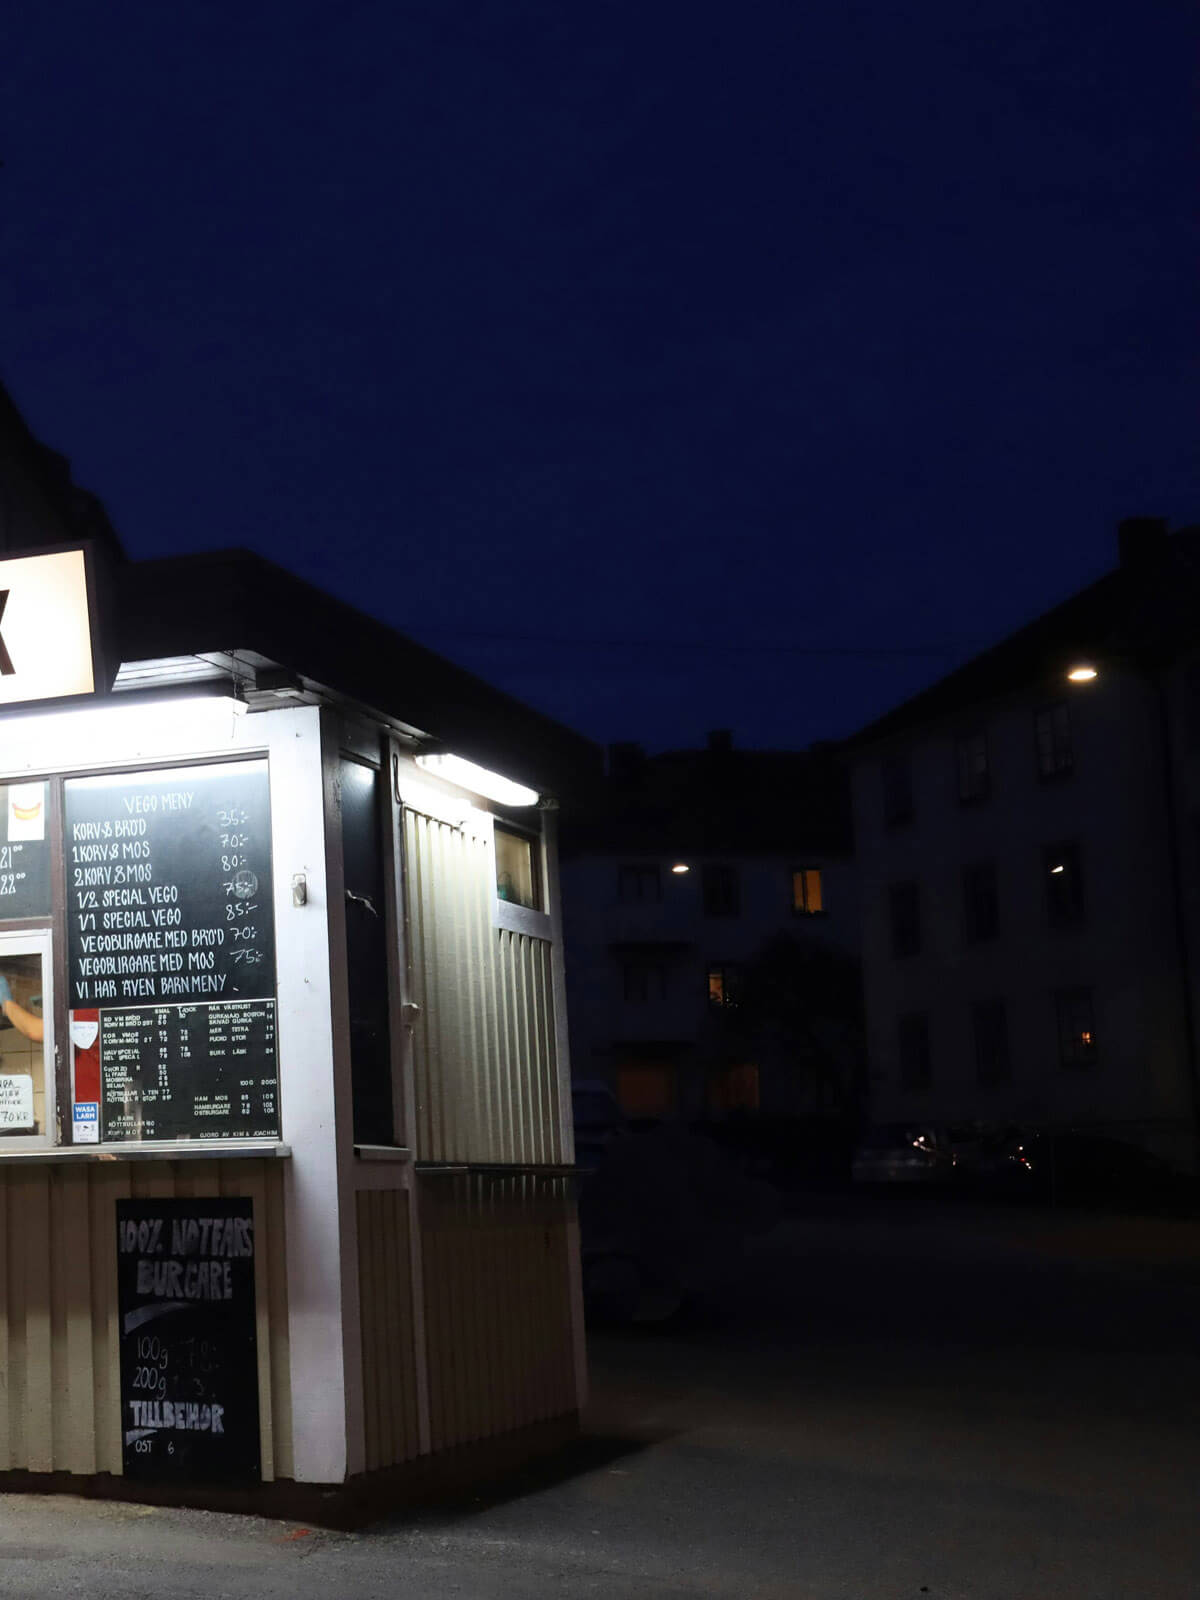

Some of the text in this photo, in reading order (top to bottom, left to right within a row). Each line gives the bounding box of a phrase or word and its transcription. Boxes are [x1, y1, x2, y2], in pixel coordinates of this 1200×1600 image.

[124, 792, 194, 814] VEGO MENY
[123, 841, 150, 858] MOS
[126, 863, 152, 882] MOS
[102, 888, 146, 907] SPECIAL
[149, 886, 178, 904] VEGO
[103, 911, 150, 929] SPECIAL
[152, 908, 181, 927] VEGO
[80, 932, 163, 952] VEGOBURGARE
[165, 930, 187, 948] MED
[79, 952, 214, 976] VEGOBURGARE MED MOS
[76, 981, 89, 999] VI
[95, 979, 117, 998] HAR
[137, 1336, 168, 1370] 100g
[132, 1366, 167, 1400] 200g
[136, 1440, 152, 1453] OST
